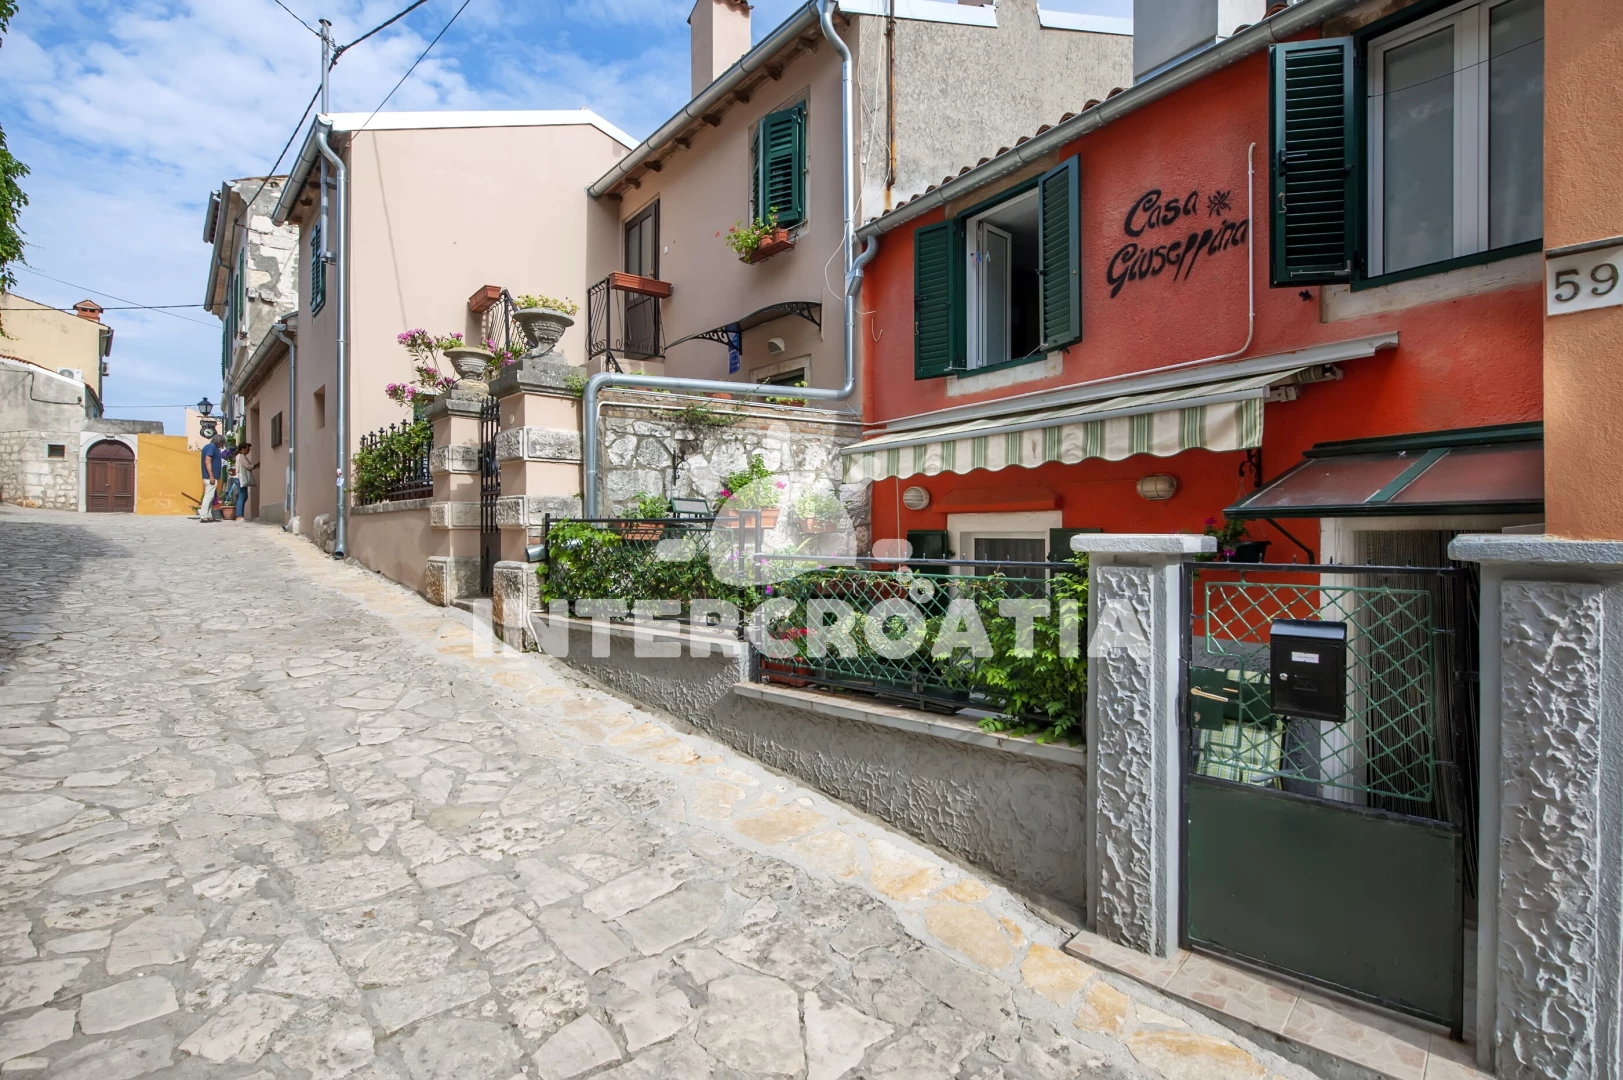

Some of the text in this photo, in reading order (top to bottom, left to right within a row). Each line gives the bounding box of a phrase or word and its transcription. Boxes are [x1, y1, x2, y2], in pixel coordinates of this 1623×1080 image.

[1124, 189, 1199, 237] Casa
[1107, 219, 1249, 298] Giuseppina
[1555, 263, 1619, 302] 59
